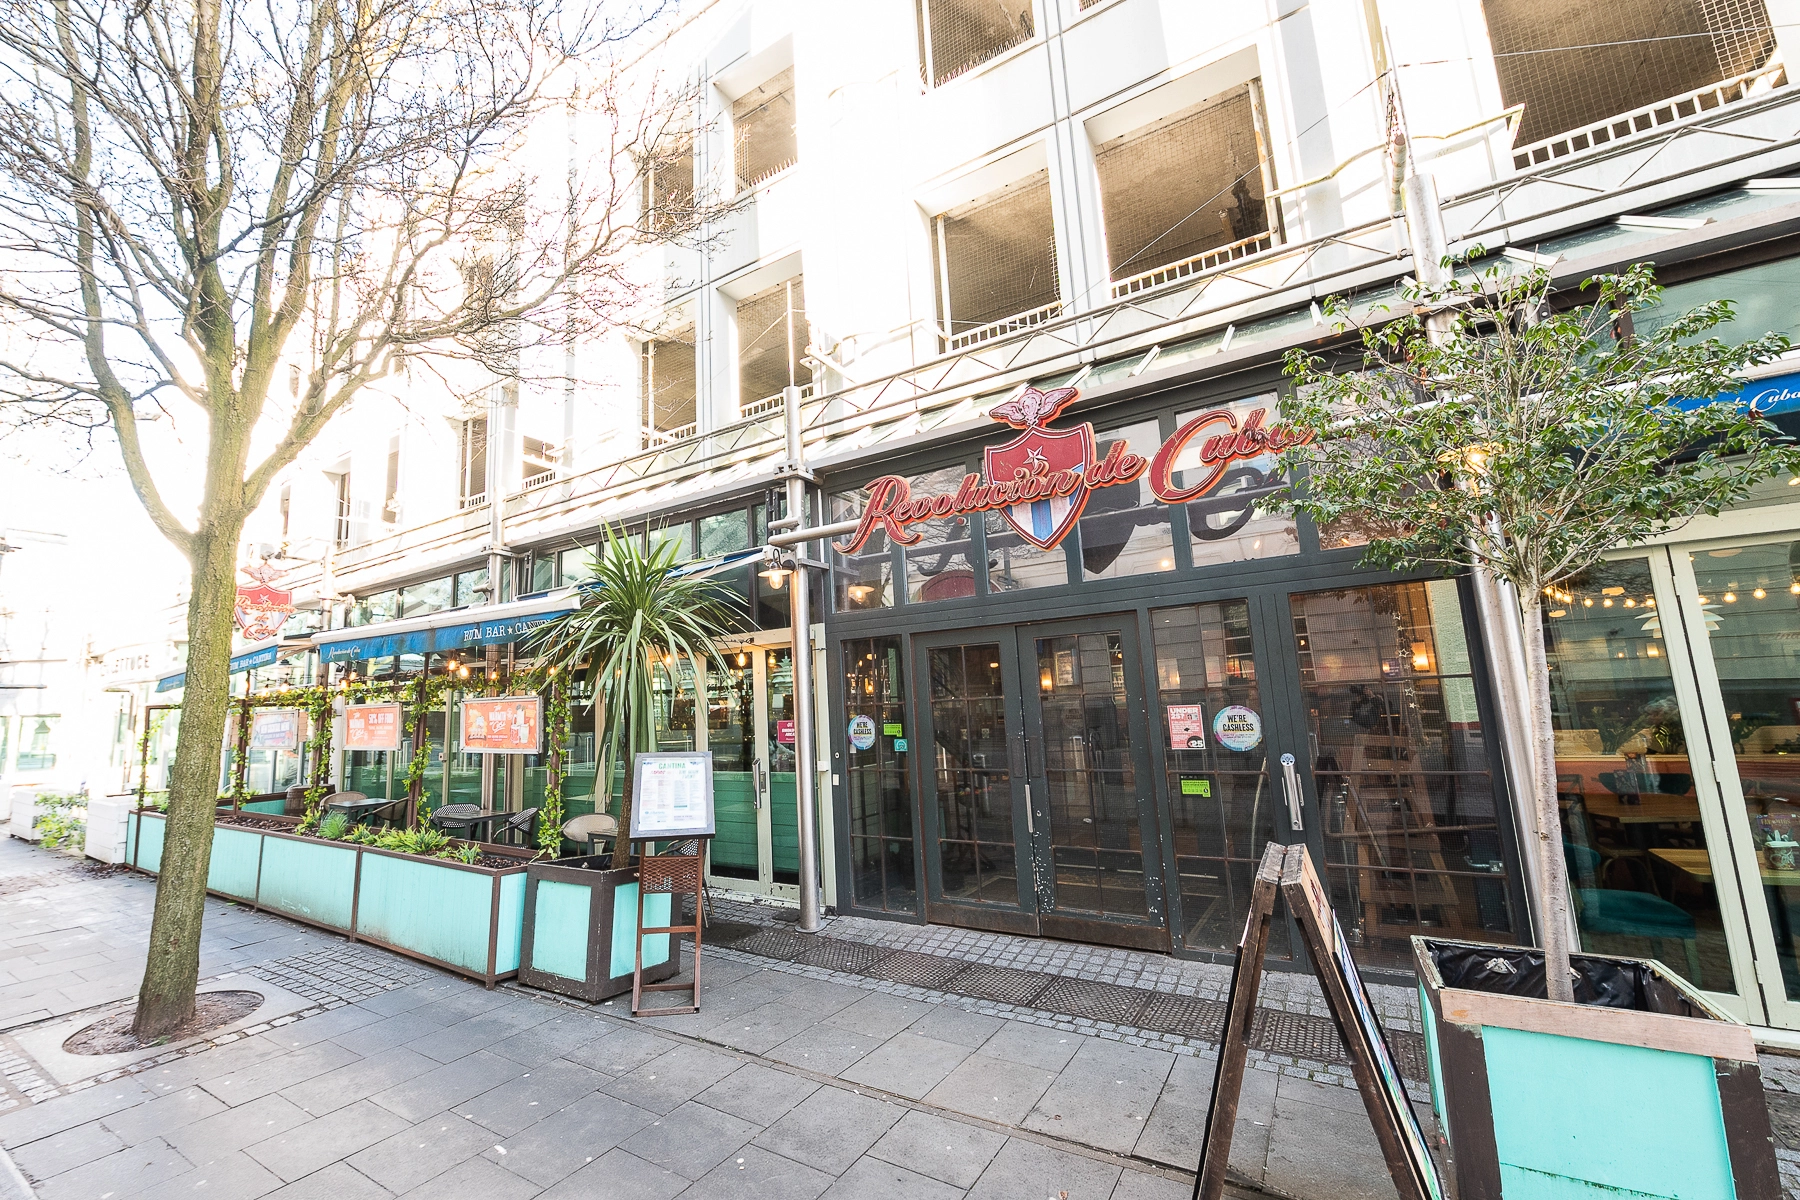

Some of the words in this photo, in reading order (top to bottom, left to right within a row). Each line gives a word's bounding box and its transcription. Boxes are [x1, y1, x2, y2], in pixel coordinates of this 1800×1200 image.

[832, 461, 1083, 554] Revolución
[1084, 440, 1150, 489] de
[1149, 408, 1317, 504] Cuba
[464, 626, 482, 641] RUM
[485, 624, 506, 638] BAR
[1227, 714, 1247, 723] WE'RE
[856, 721, 869, 729] WE'RE
[1222, 723, 1254, 732] CASHLESS
[658, 762, 686, 770] CANTINA
